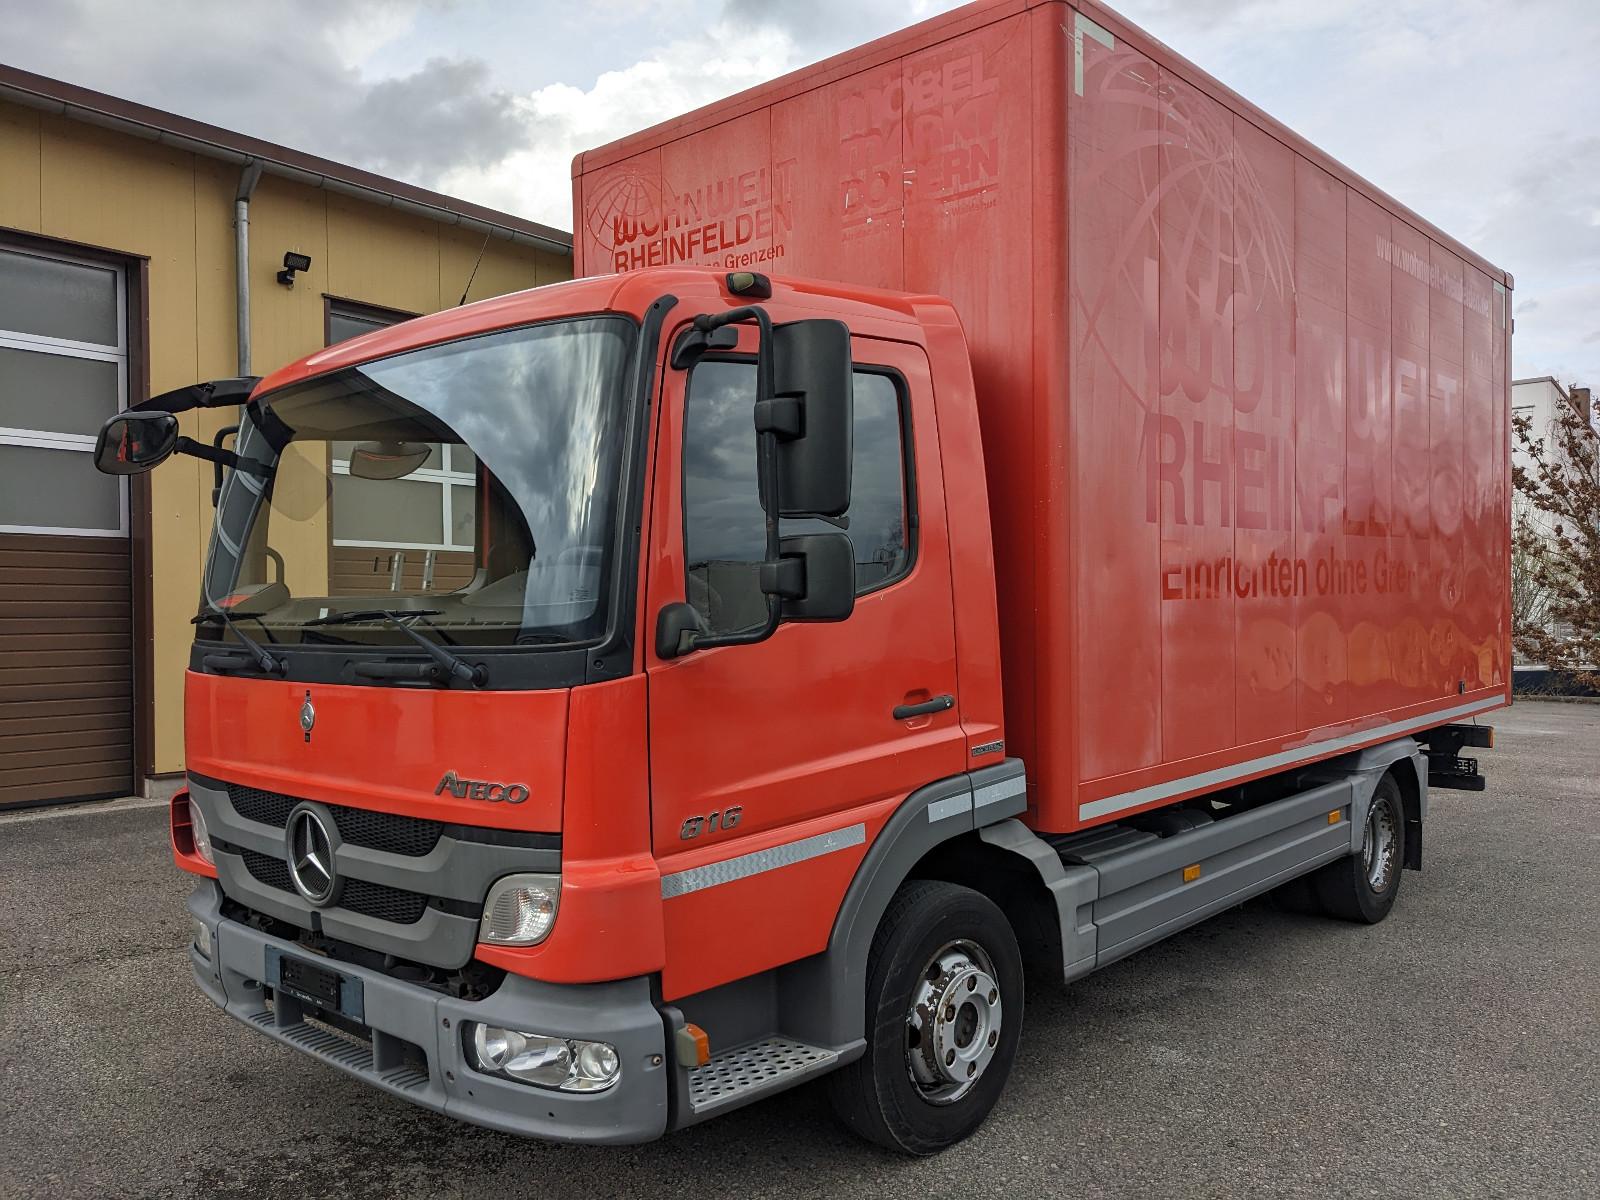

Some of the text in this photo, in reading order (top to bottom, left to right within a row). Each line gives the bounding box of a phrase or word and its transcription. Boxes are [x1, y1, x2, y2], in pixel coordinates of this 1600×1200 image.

[613, 157, 797, 247] WOHNWELT
[614, 201, 792, 273] RHEINFELDEN
[724, 243, 785, 269] Grenzen
[1143, 257, 1457, 443] WOHNWELT
[1144, 411, 1457, 540] RHEINFEL
[1315, 547, 1367, 597] ohne
[680, 806, 743, 841] 816
